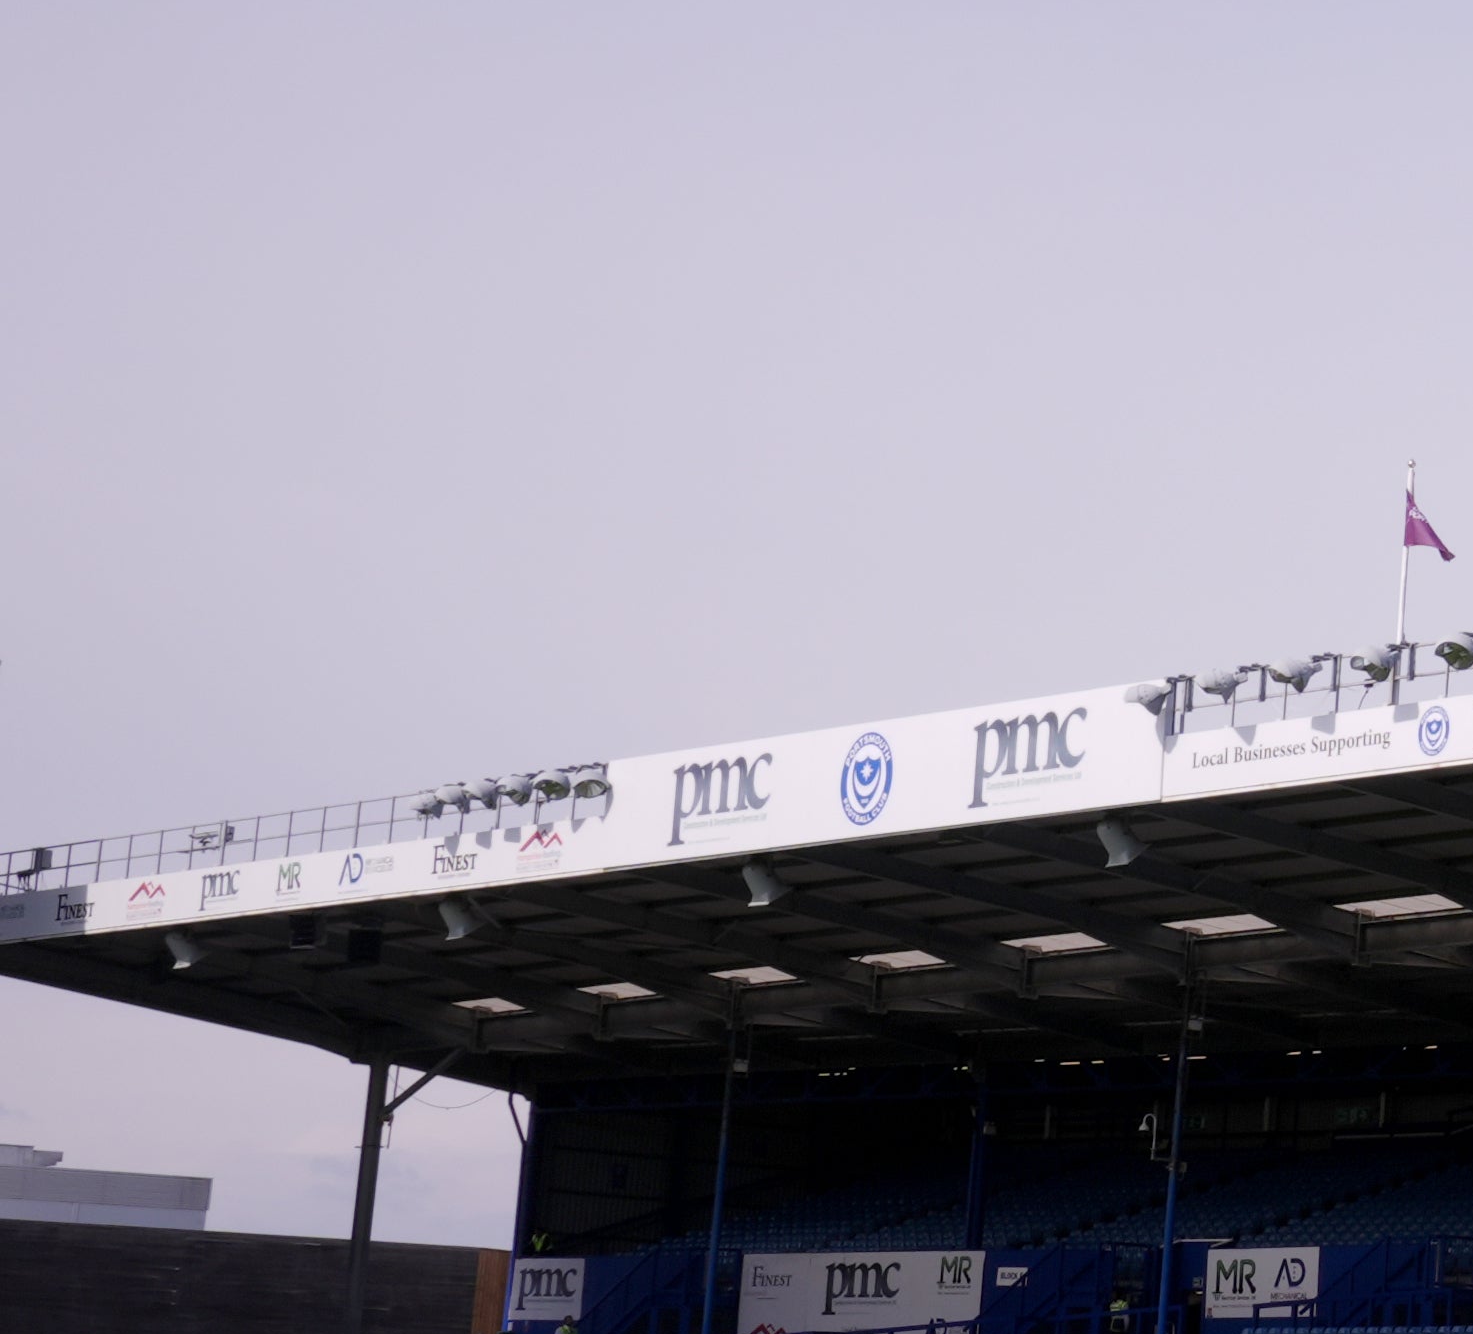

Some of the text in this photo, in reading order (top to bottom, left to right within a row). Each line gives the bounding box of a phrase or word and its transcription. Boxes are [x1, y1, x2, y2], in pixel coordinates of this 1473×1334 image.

[845, 733, 891, 766] PORTSMOUTH
[968, 707, 1088, 809] pmc
[1192, 747, 1229, 769] Local
[1234, 741, 1306, 764] Businesses
[1310, 729, 1392, 758] Supporting
[667, 752, 773, 847] pmc
[843, 792, 889, 825] FOOTBALL CLUB
[276, 862, 303, 893] MR
[432, 845, 478, 874] FINEST
[56, 893, 96, 921] FINEST
[199, 870, 242, 911] pmc
[515, 1268, 577, 1310] pmc
[752, 1255, 973, 1315] FINEST pmc MR
[1213, 1259, 1257, 1295] MR
